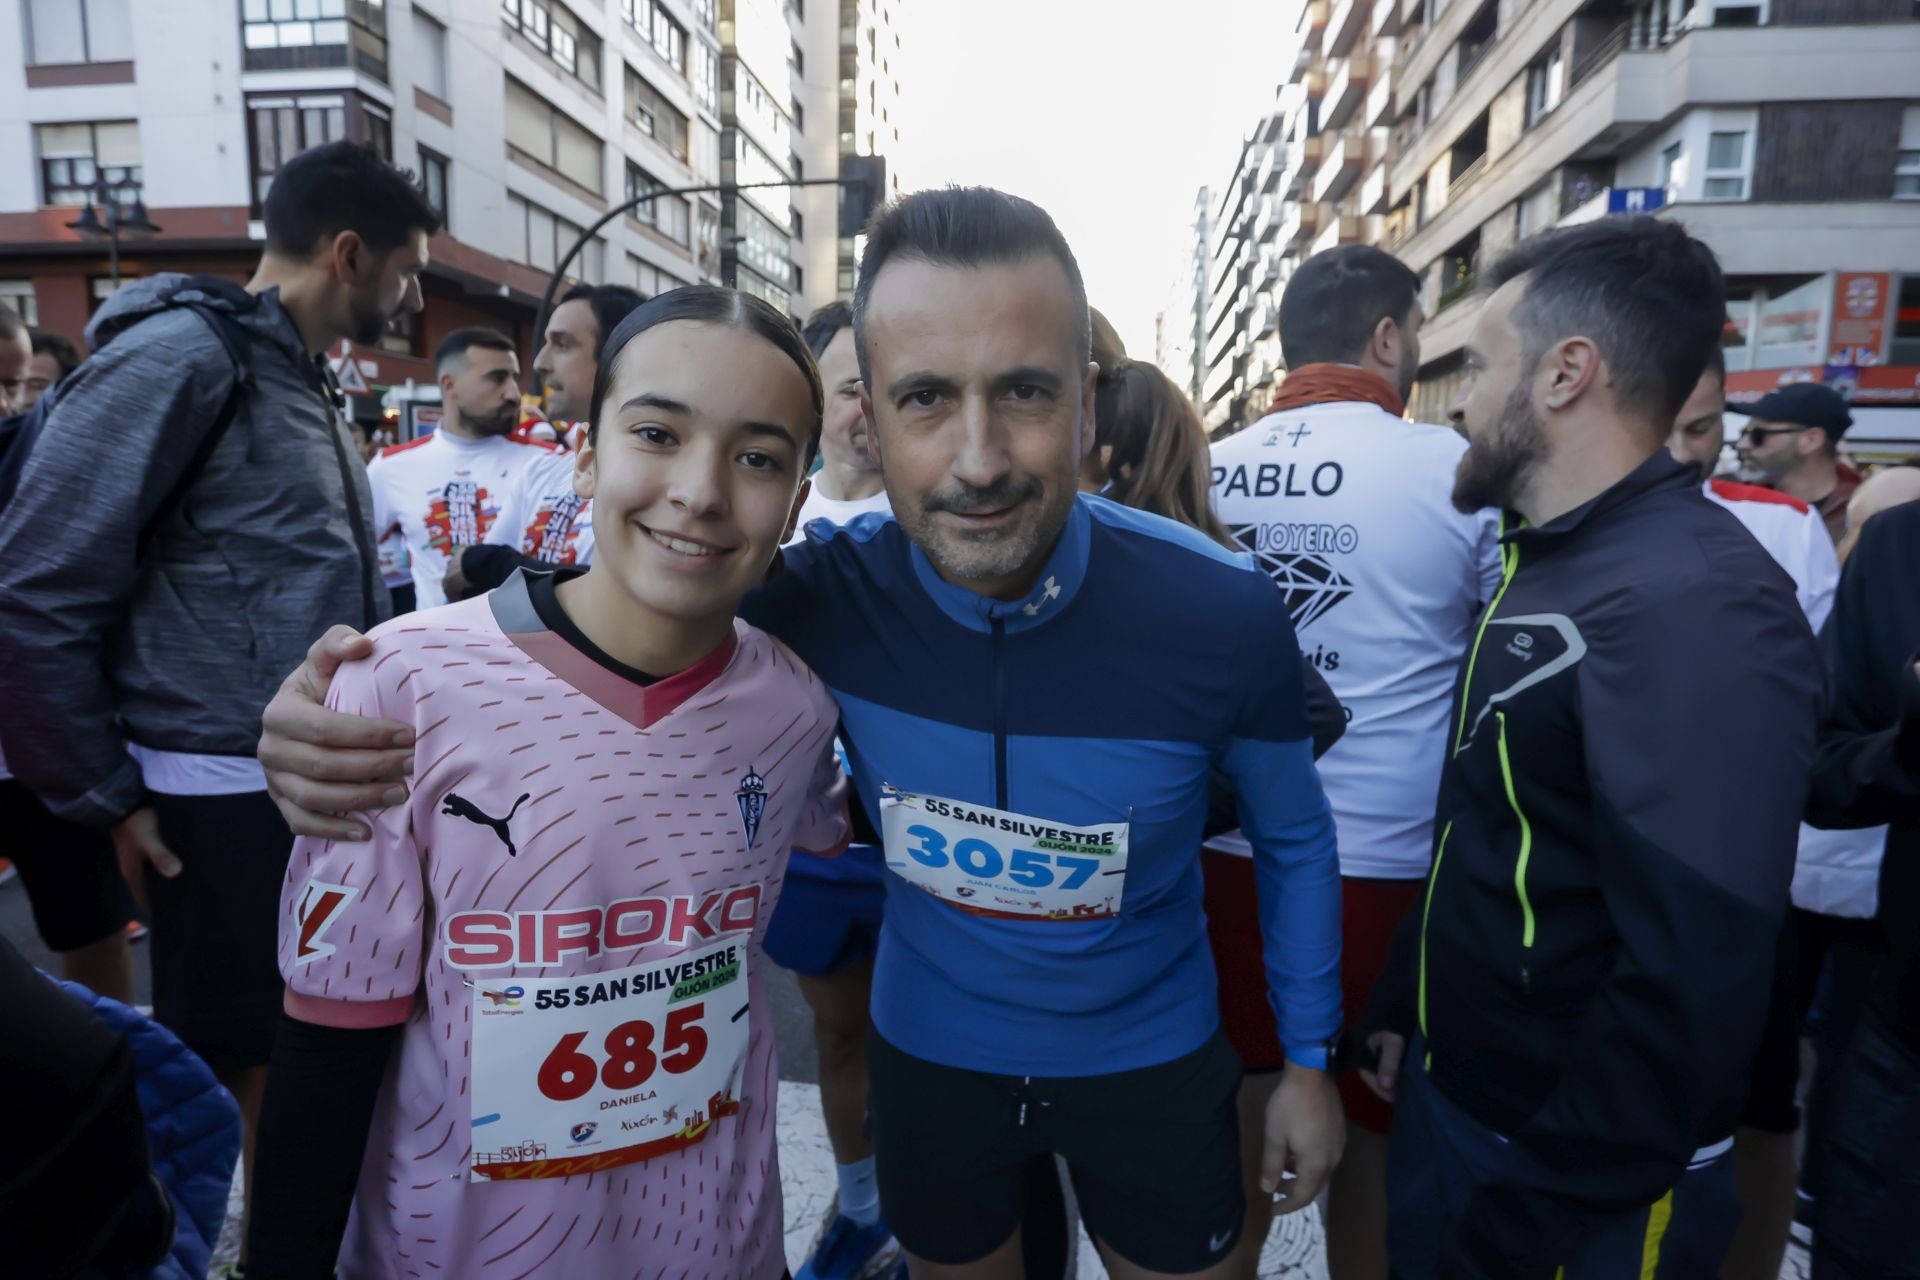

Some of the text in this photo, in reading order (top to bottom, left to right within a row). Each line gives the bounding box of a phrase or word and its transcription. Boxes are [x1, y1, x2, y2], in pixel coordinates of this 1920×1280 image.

[1211, 461, 1344, 498] PABLO
[1258, 522, 1359, 554] JOYERO
[925, 798, 1114, 846] 55 SAN SILVESTRE
[907, 824, 1100, 890] 3057
[1080, 843, 1112, 855] 2024
[965, 878, 1037, 896] JUAN CARLOS
[446, 886, 764, 968] SIROKO
[535, 946, 736, 1010] 55 SAN SILVESTRE
[712, 968, 736, 987] 2024
[537, 1002, 708, 1101] 685
[600, 1089, 658, 1111] DANIELA
